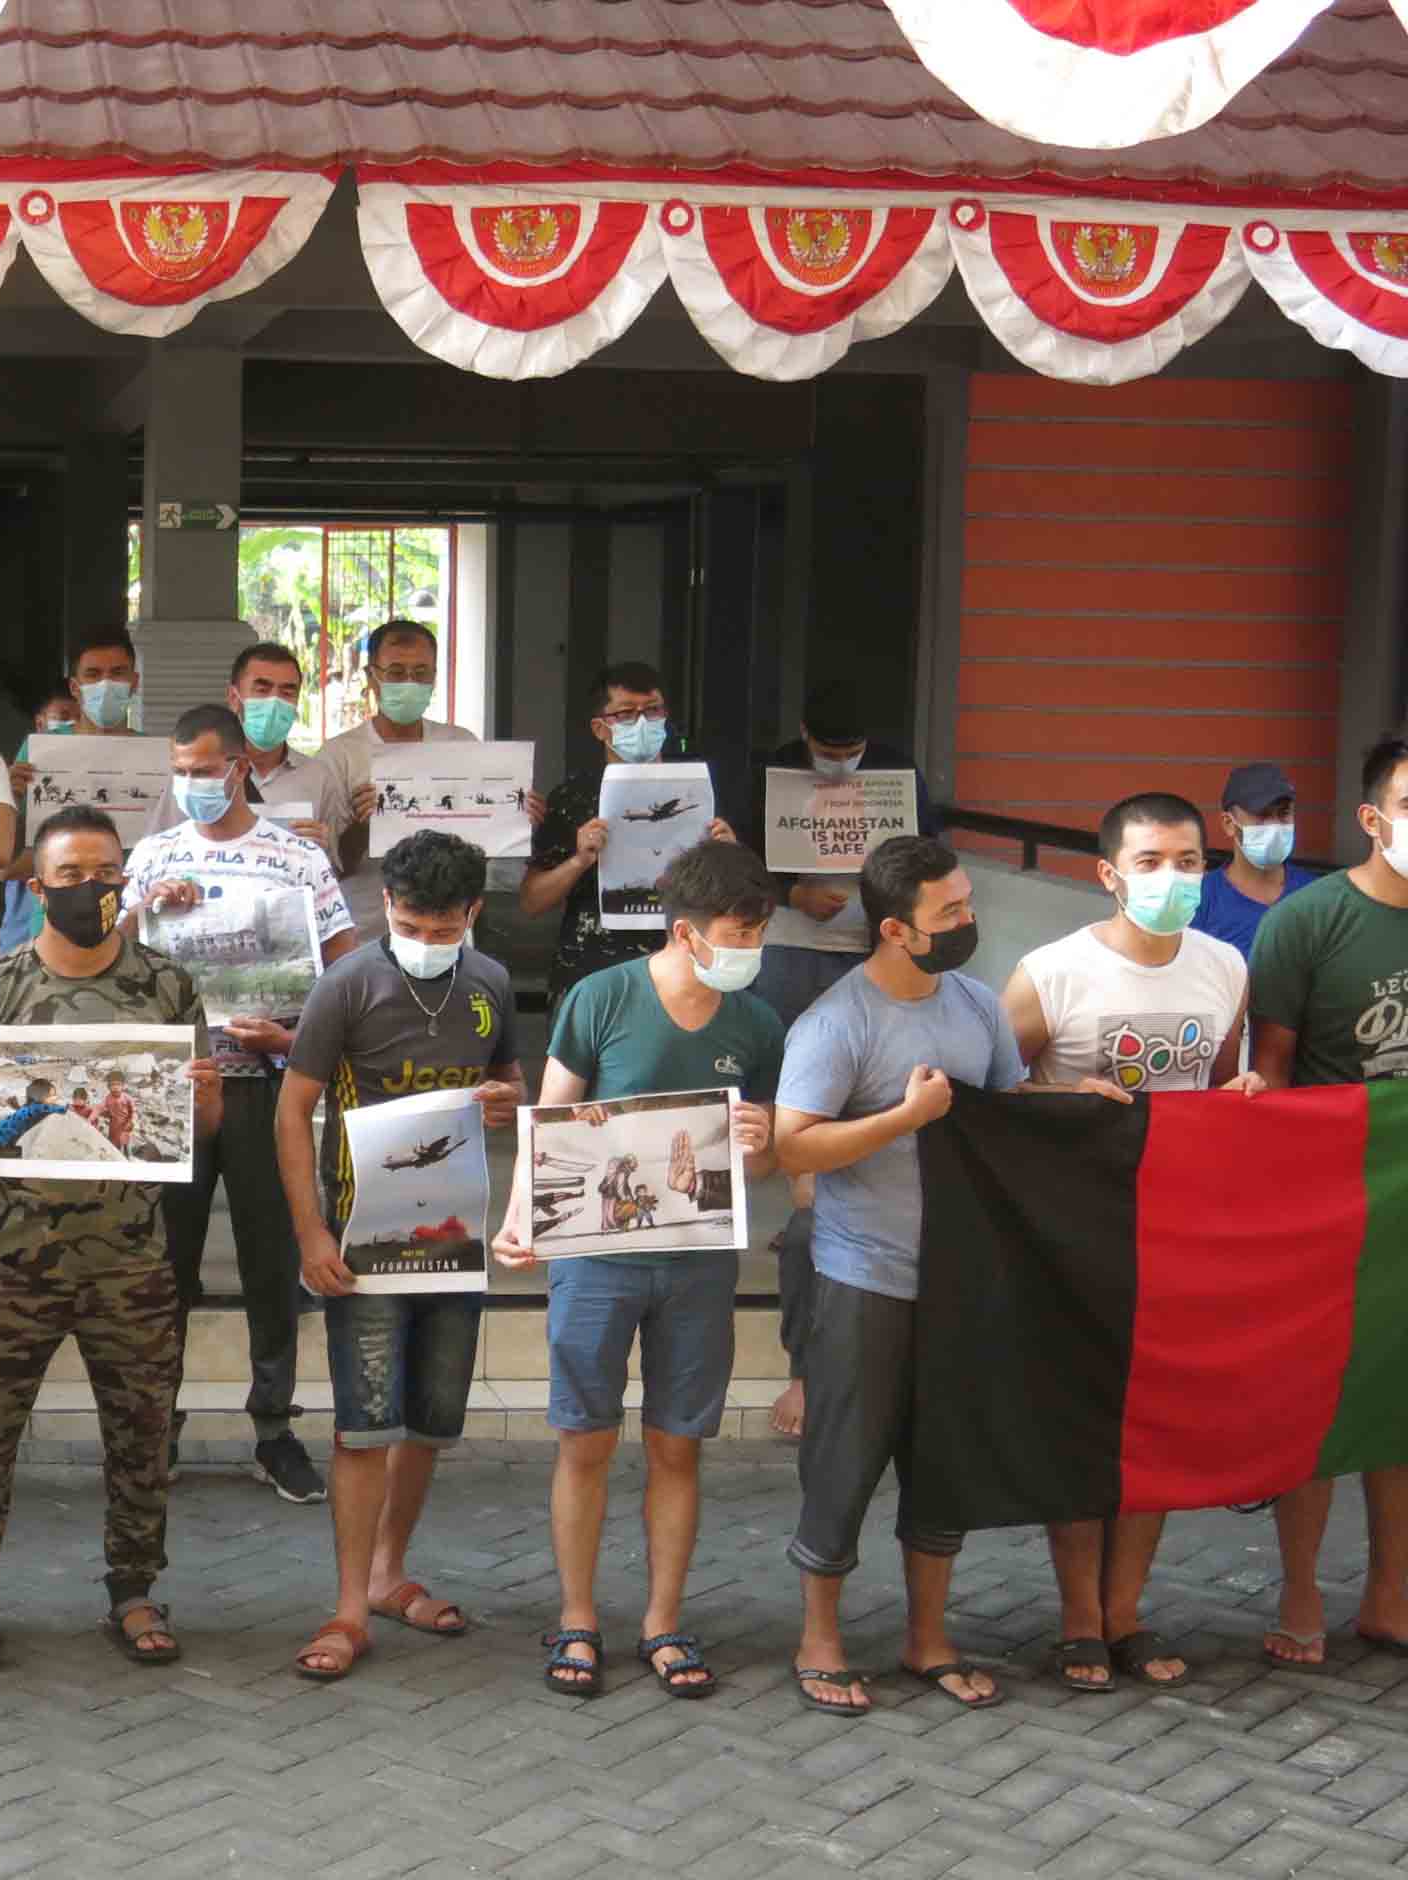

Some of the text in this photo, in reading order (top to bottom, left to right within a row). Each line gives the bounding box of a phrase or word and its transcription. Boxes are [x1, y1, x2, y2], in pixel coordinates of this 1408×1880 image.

[776, 816, 905, 831] AFGHANISTAN
[811, 831, 870, 842] IS NOT
[819, 843, 865, 856] SAFE
[204, 850, 245, 864] FILA
[1102, 1017, 1213, 1092] Bali
[371, 1259, 459, 1273] AFGHANISTAN
